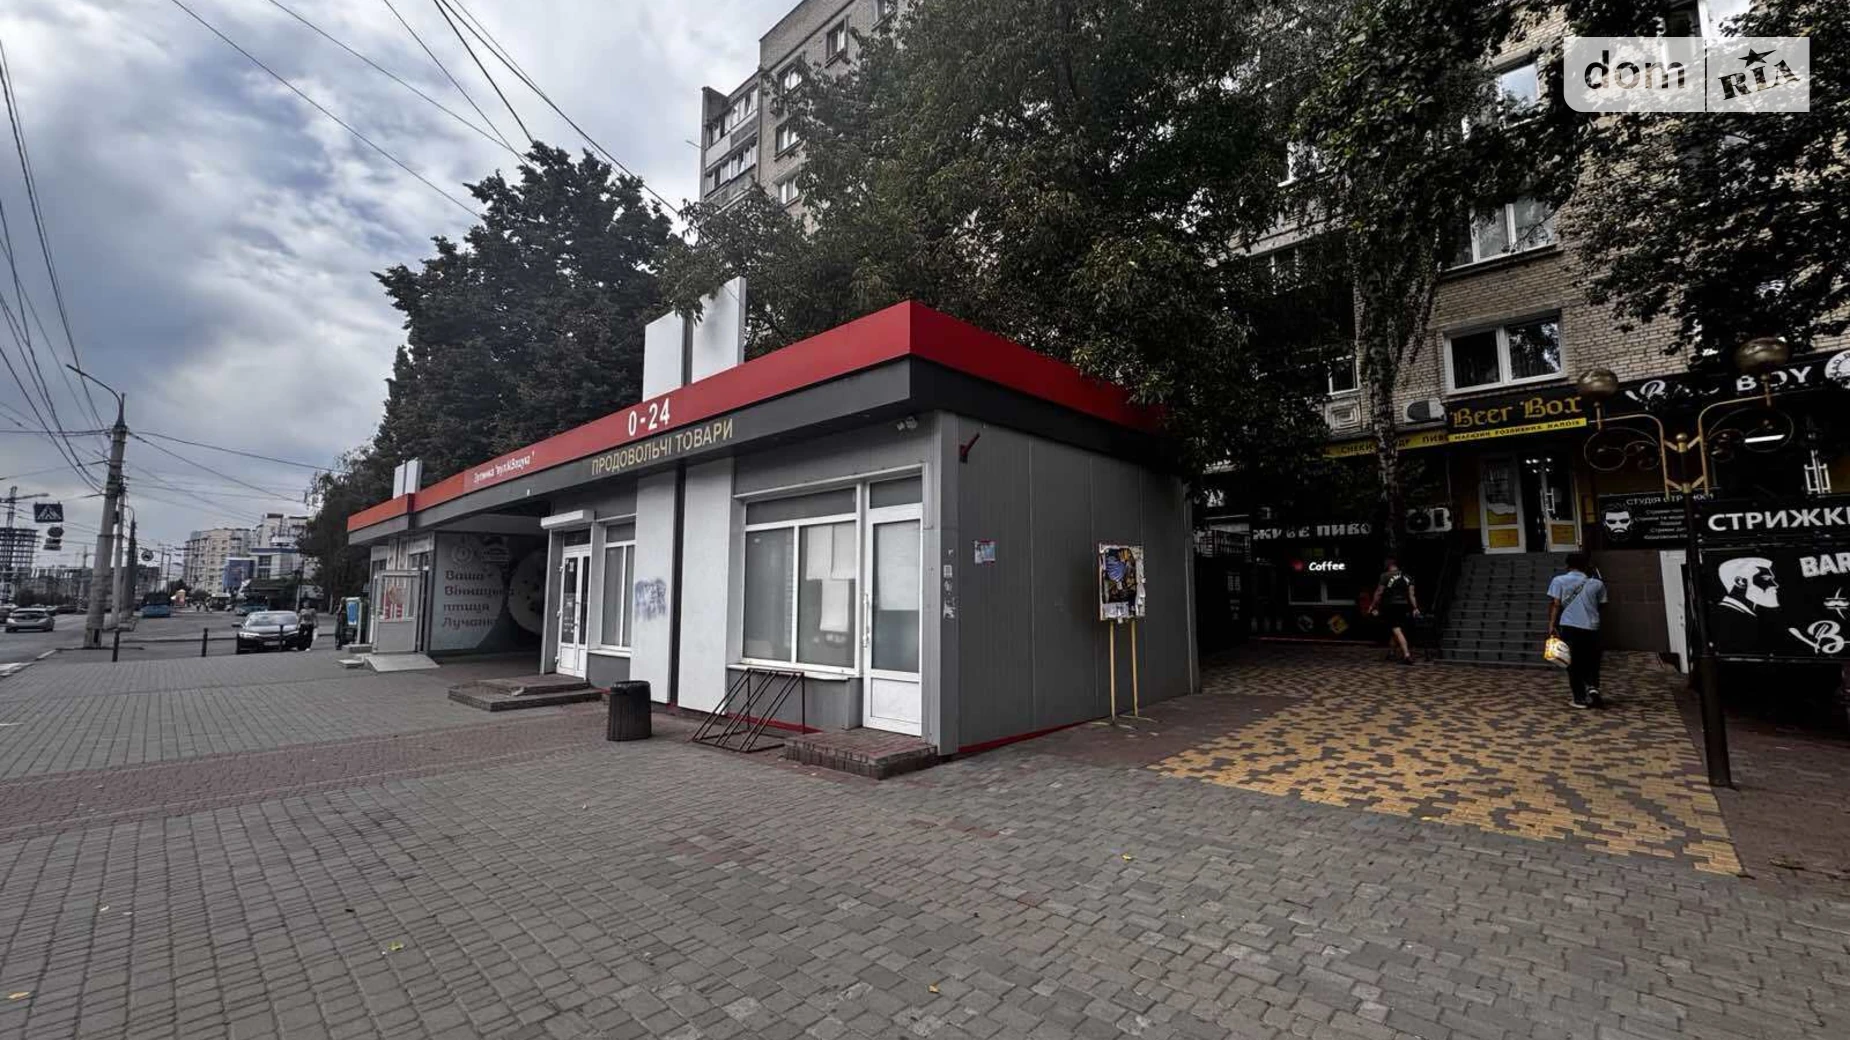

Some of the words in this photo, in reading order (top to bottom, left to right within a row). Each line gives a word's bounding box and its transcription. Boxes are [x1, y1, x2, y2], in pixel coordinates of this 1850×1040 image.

[628, 398, 670, 436] 0-24
[1452, 407, 1513, 428] Beer
[1520, 395, 1583, 419] Box
[591, 438, 671, 475] ПРОДОВОЛЬЧІ
[675, 418, 733, 452] ТОВАРИ
[1308, 560, 1347, 572] Coffee
